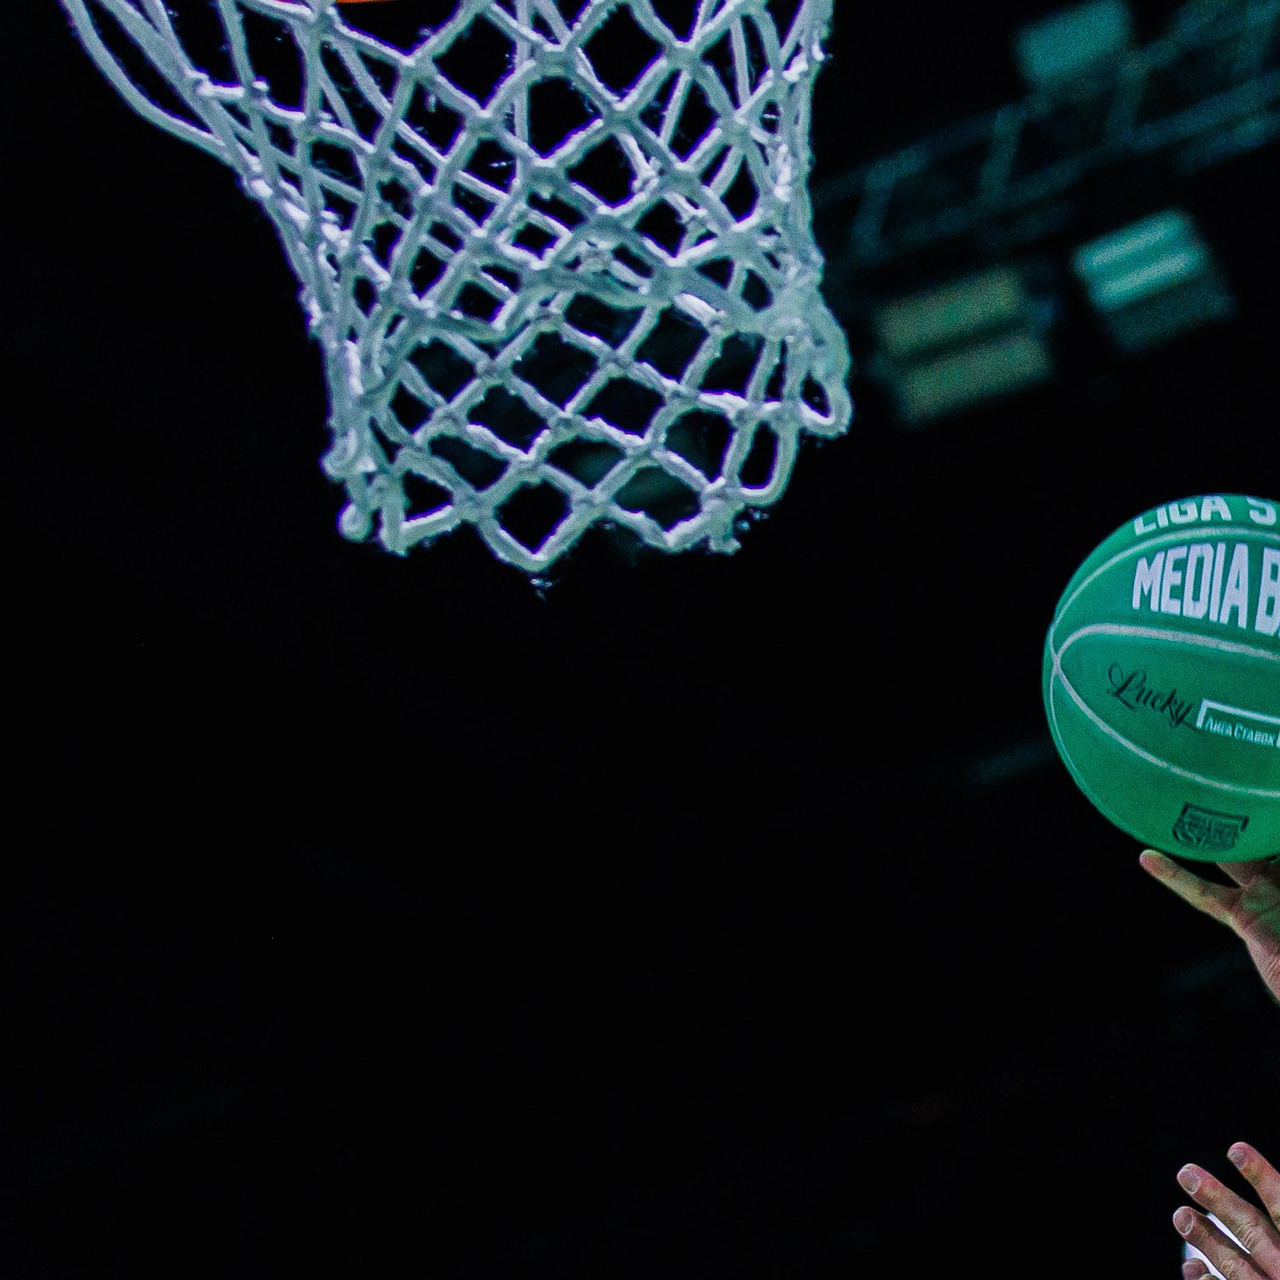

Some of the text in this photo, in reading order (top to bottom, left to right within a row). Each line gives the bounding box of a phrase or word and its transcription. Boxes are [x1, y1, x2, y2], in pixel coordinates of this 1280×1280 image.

[1133, 495, 1232, 536] LIGA
[1132, 541, 1249, 631] MEDIA
[1106, 662, 1199, 732] Lucky
